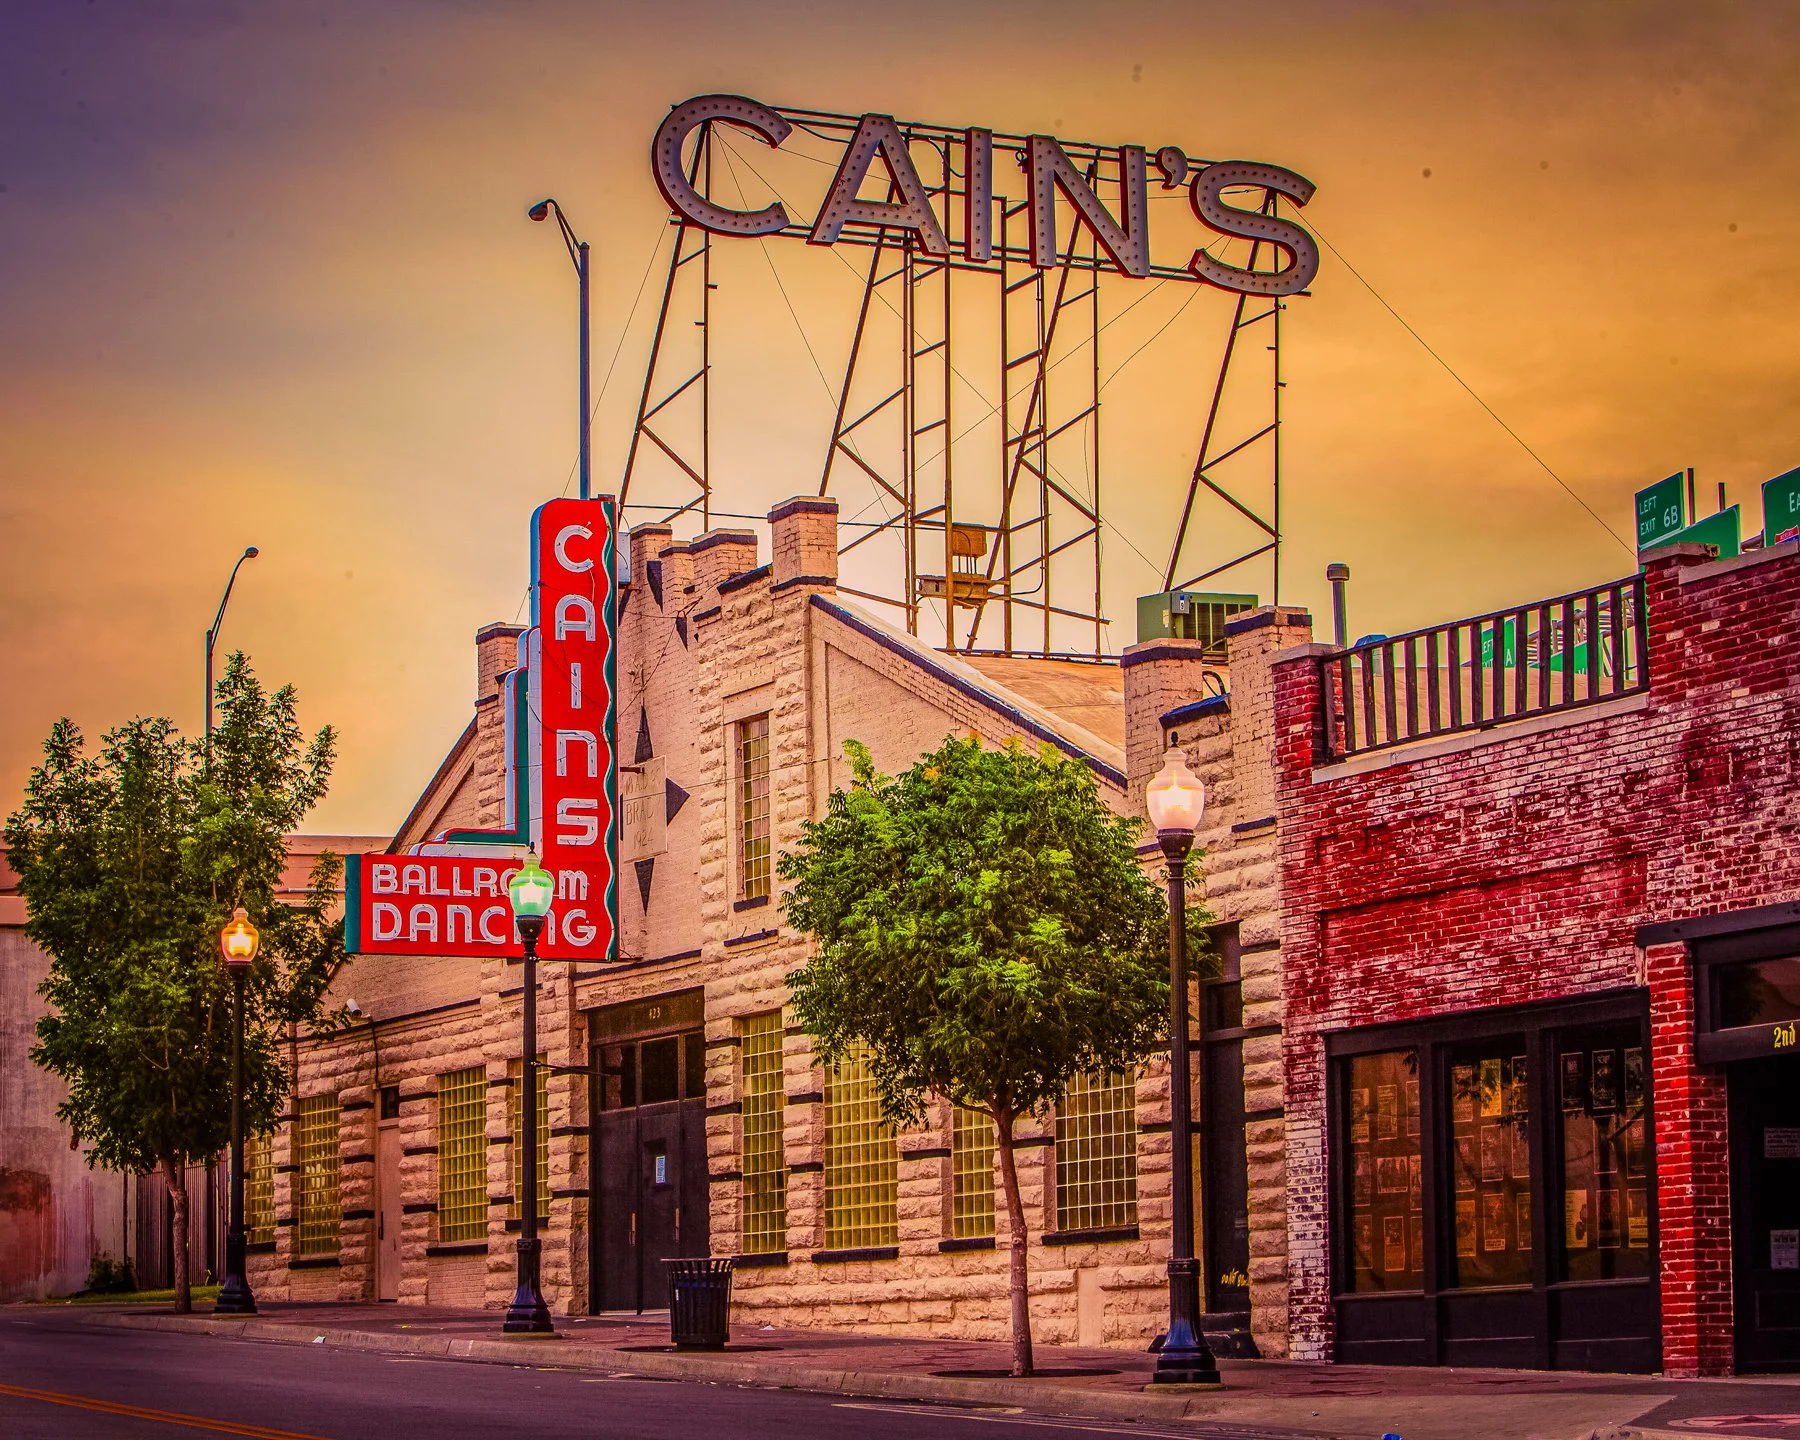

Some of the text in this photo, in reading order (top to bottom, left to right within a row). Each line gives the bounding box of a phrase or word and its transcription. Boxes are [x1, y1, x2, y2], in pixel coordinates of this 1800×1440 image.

[651, 94, 1319, 297] CAIN'S
[1639, 495, 1657, 515] LEFT
[1663, 505, 1678, 528] 6B
[1640, 517, 1656, 536] EXIT
[555, 523, 599, 846] CAINS
[372, 863, 588, 901] BALLRM
[1773, 1022, 1796, 1048] 2nd
